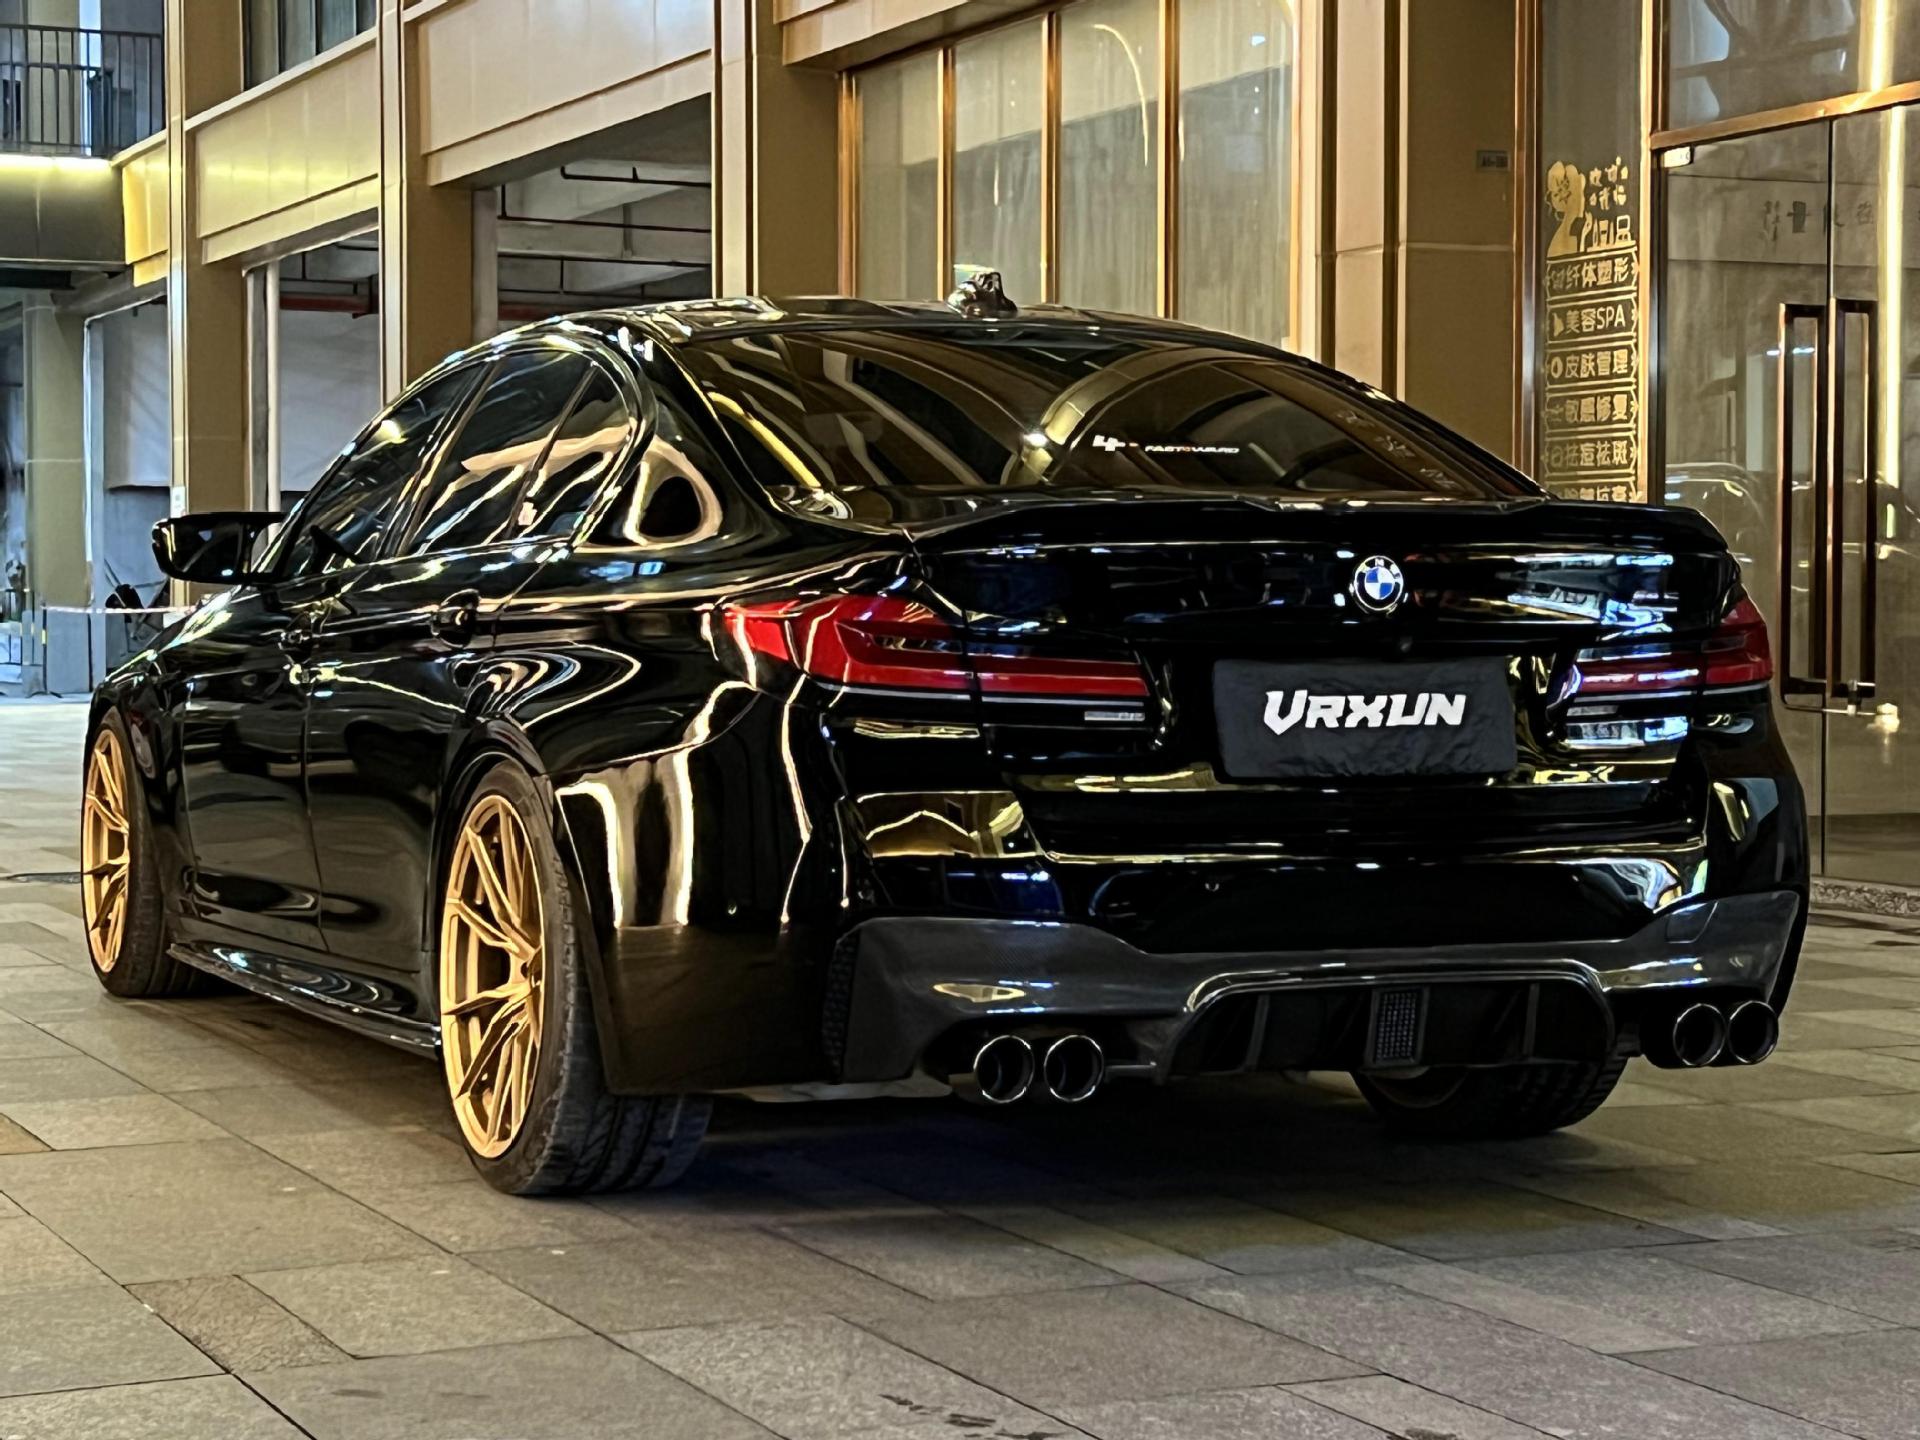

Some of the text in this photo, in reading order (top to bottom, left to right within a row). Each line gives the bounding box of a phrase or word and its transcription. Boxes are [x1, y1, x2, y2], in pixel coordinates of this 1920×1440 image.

[1565, 304, 1626, 334] 美容SPA
[1564, 349, 1628, 378] 皮肤管理
